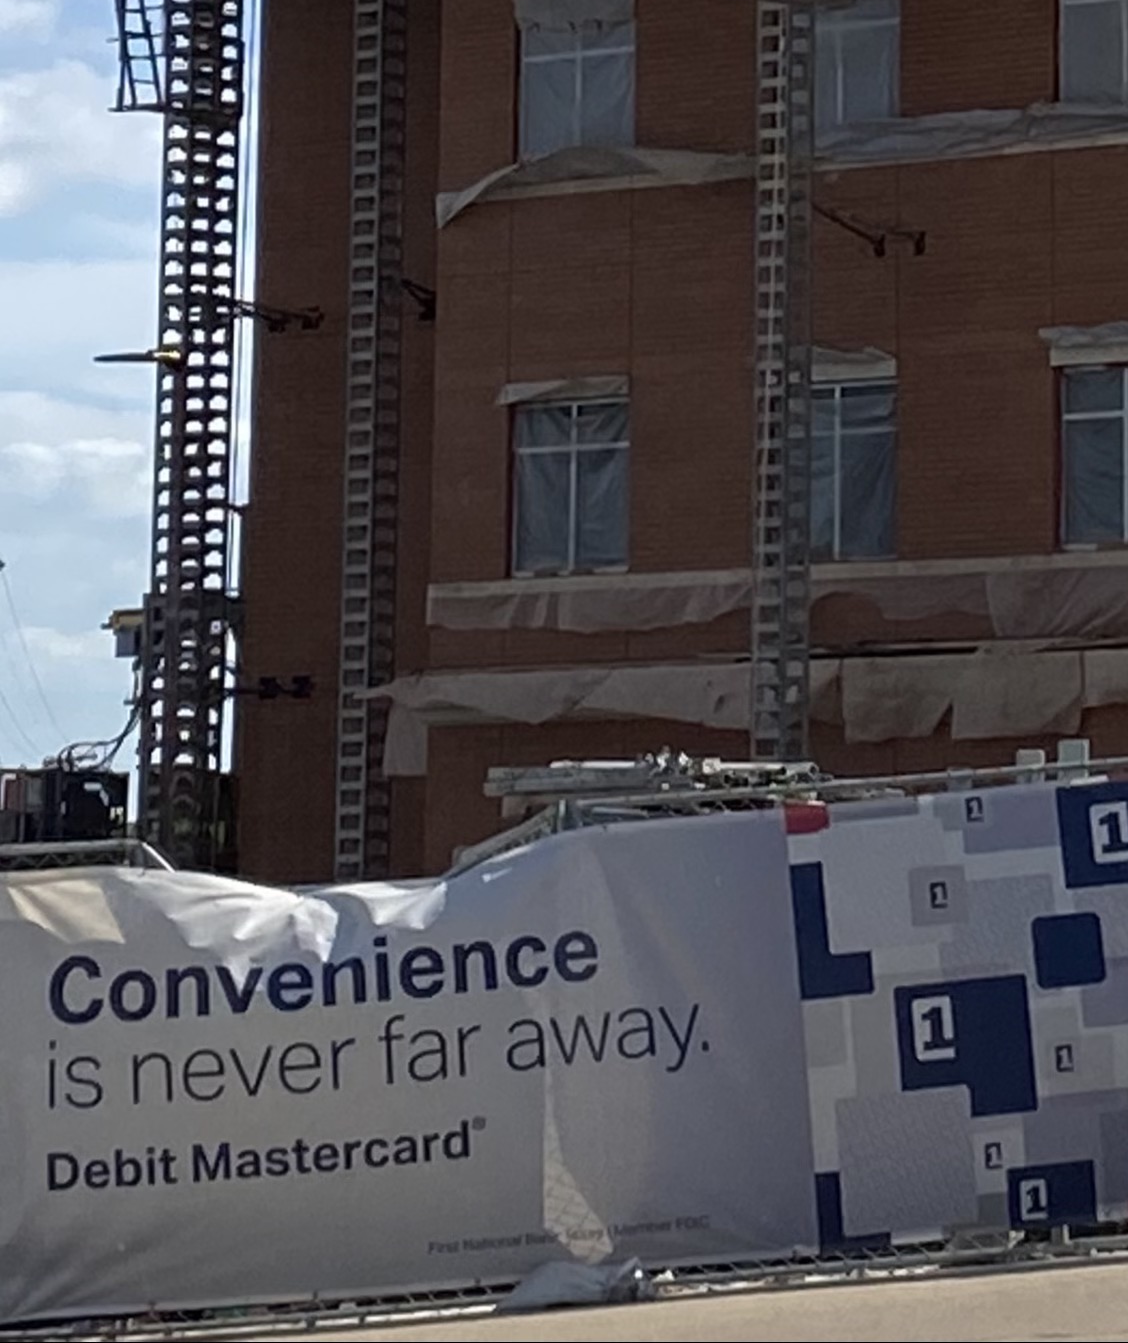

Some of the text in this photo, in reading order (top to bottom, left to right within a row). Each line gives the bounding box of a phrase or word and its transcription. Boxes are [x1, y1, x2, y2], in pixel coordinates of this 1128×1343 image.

[49, 929, 599, 1024] Convenience
[48, 1003, 710, 1109] is never far away.
[46, 1146, 178, 1191] Debit
